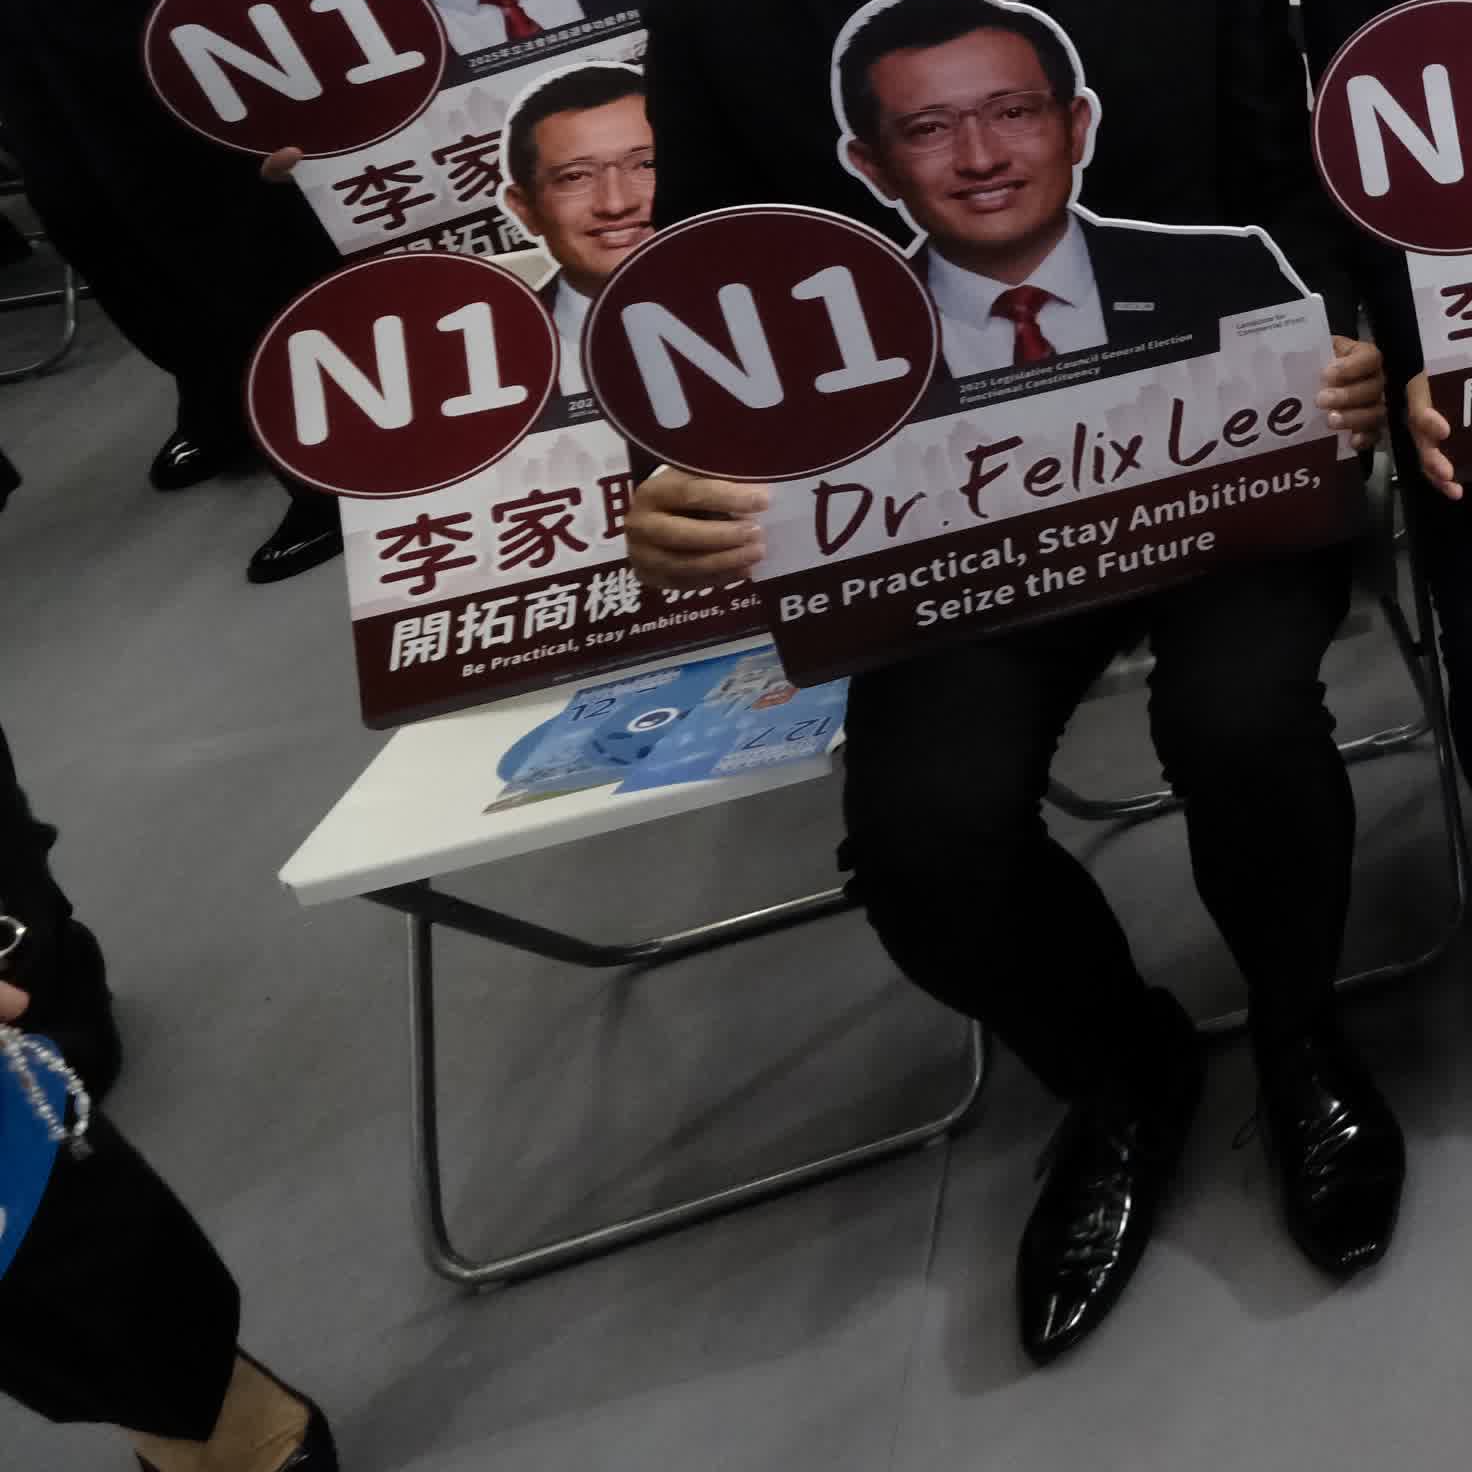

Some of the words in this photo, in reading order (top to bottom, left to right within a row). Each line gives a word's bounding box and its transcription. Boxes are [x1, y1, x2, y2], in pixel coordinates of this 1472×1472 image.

[287, 301, 529, 448] N1
[620, 265, 911, 430] N1
[779, 590, 830, 623] Be
[841, 537, 1028, 607] Practical,
[1037, 513, 1120, 556] Stay
[1128, 465, 1323, 534] Ambitious,
[813, 479, 949, 556] Dr.
[960, 422, 1144, 519] Felix
[1167, 391, 1306, 468] Lee
[461, 662, 483, 679] Be
[491, 638, 580, 670] Practical,
[585, 629, 623, 652] Stay
[629, 603, 725, 636] Ambitious,
[914, 584, 1016, 628] Seize
[1025, 561, 1087, 598] the
[1097, 529, 1216, 579] Future
